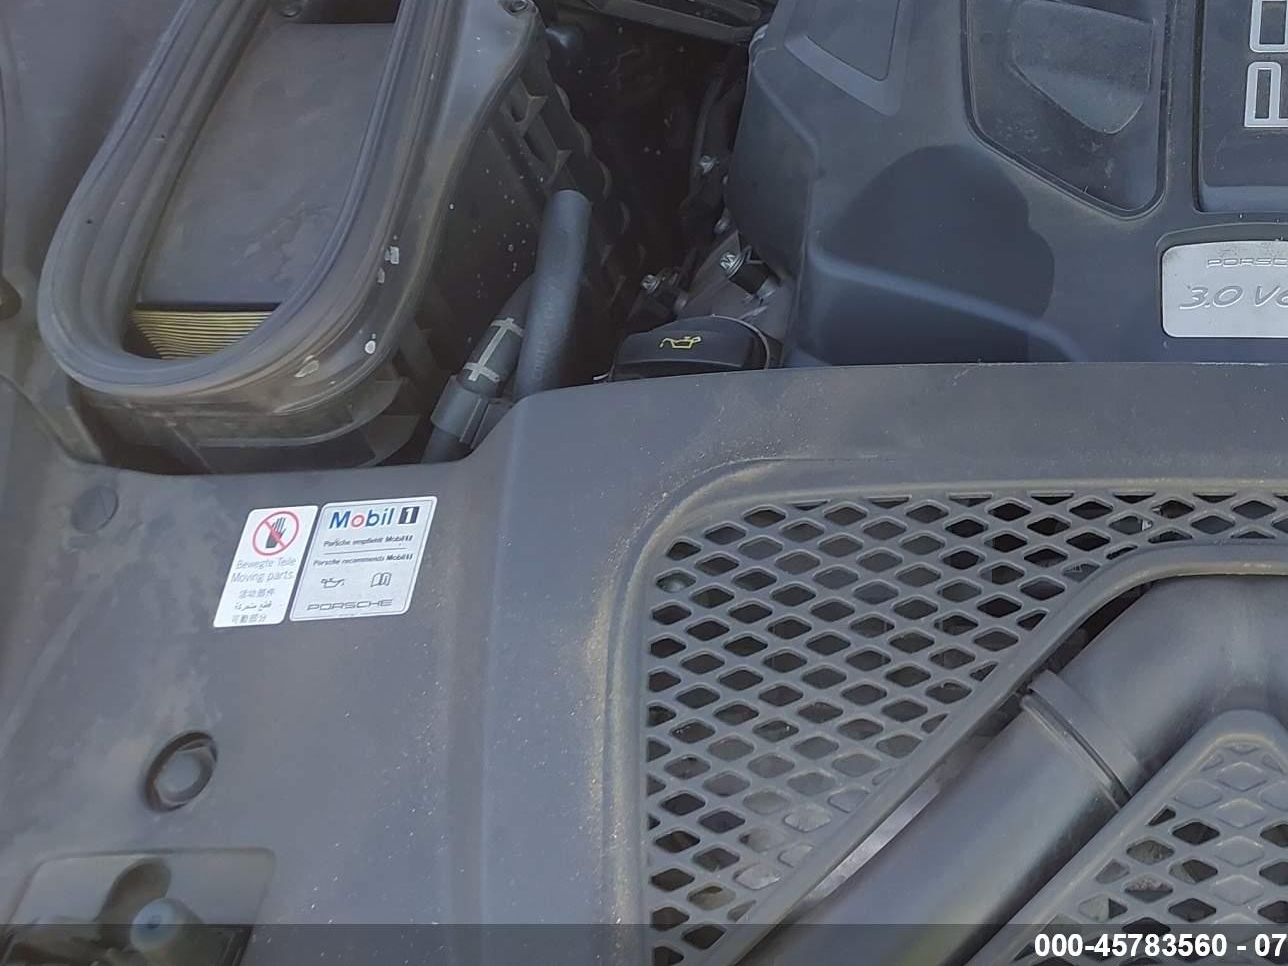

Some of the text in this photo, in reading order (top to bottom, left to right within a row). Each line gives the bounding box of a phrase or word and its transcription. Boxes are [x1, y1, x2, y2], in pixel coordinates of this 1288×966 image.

[1179, 285, 1244, 310] 3.0
[328, 507, 418, 529] Mobil 1
[323, 537, 351, 547] Porsche
[235, 558, 275, 570] Bewegte
[313, 558, 340, 566] Porsche
[342, 556, 384, 565] recommends
[231, 570, 295, 583] Moving parts
[307, 599, 393, 611] PORSCHE
